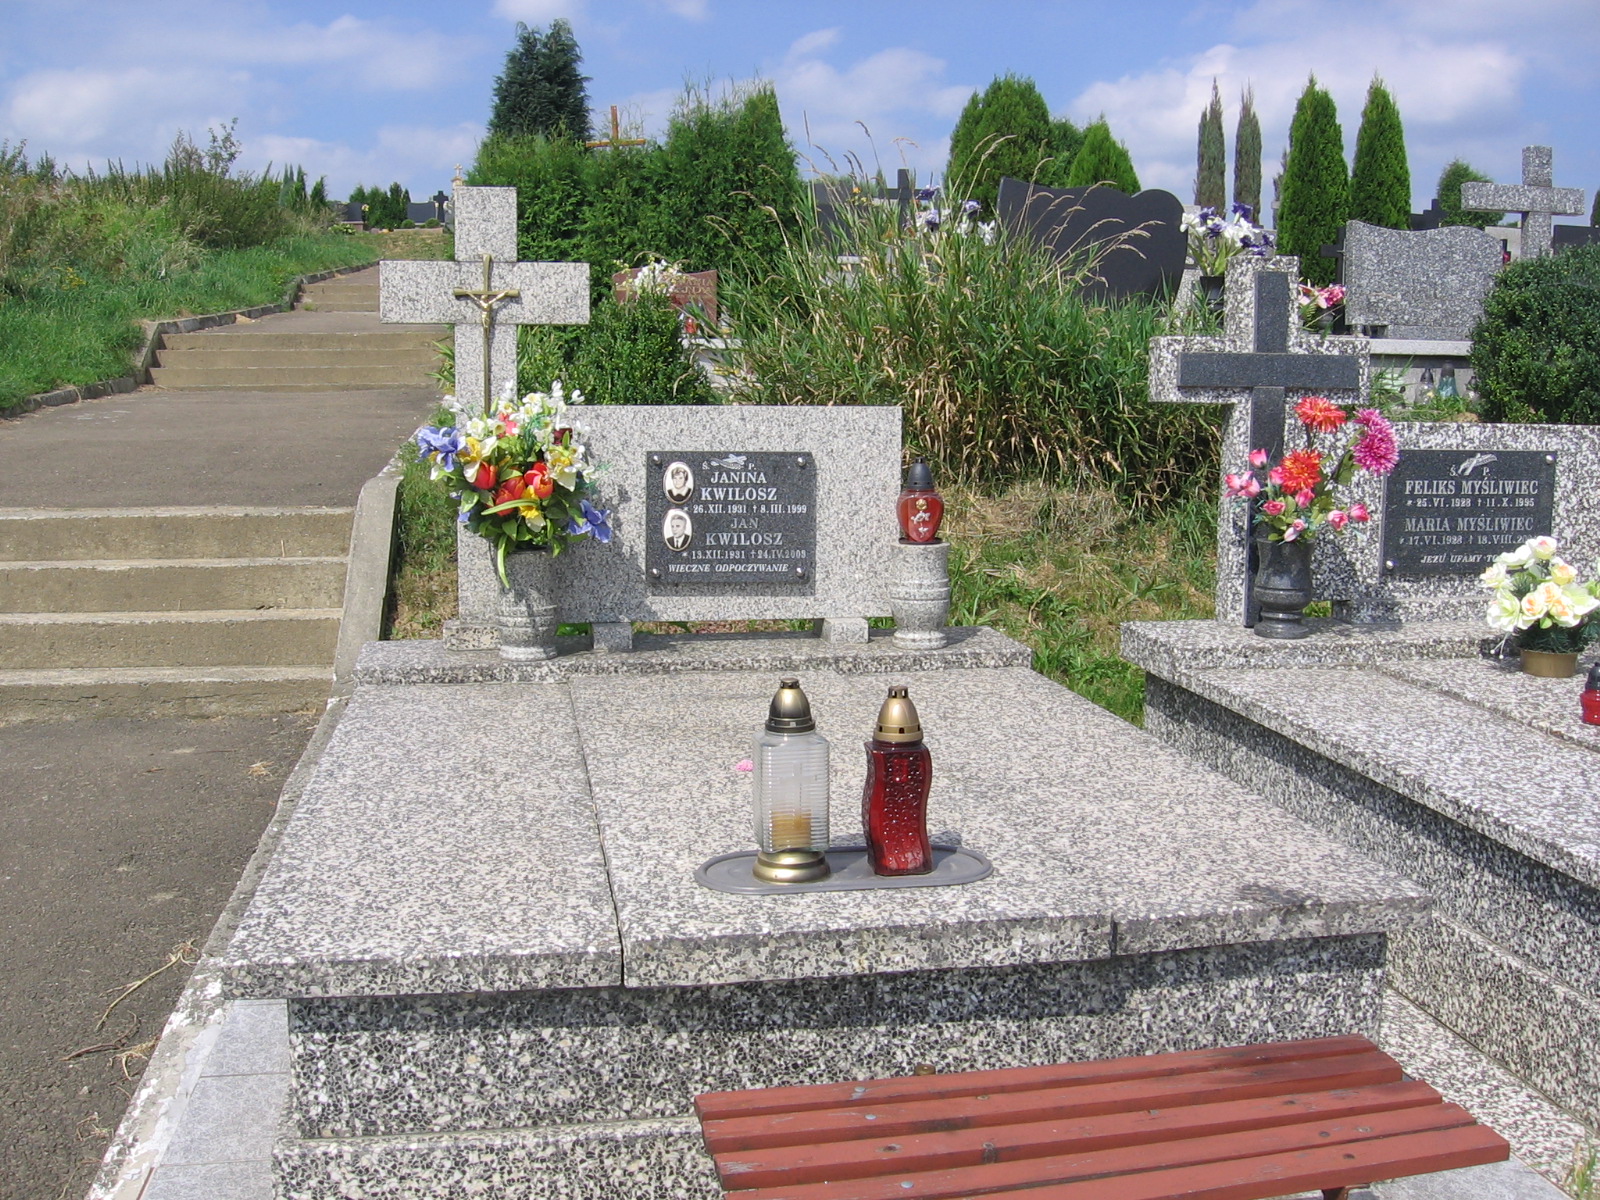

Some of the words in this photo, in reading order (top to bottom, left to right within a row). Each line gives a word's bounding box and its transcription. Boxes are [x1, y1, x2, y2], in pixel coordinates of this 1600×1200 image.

[710, 472, 767, 484] JANINA
[1404, 480, 1456, 495] FELIKS
[1460, 477, 1539, 495] MYŚLIWIEC
[700, 488, 778, 501] KWILOSZ
[693, 504, 747, 514] 26.XII.1931
[730, 518, 759, 529] JAN
[1404, 517, 1450, 532] MARIA
[1457, 514, 1534, 532] MYŚLIWIEC
[705, 533, 783, 546] KWILOSZ
[1420, 553, 1446, 564] JEZU
[1450, 554, 1483, 563] UFAMY
[668, 564, 711, 573] WIECZNE
[715, 564, 789, 572] ODPOCZYWANIE
